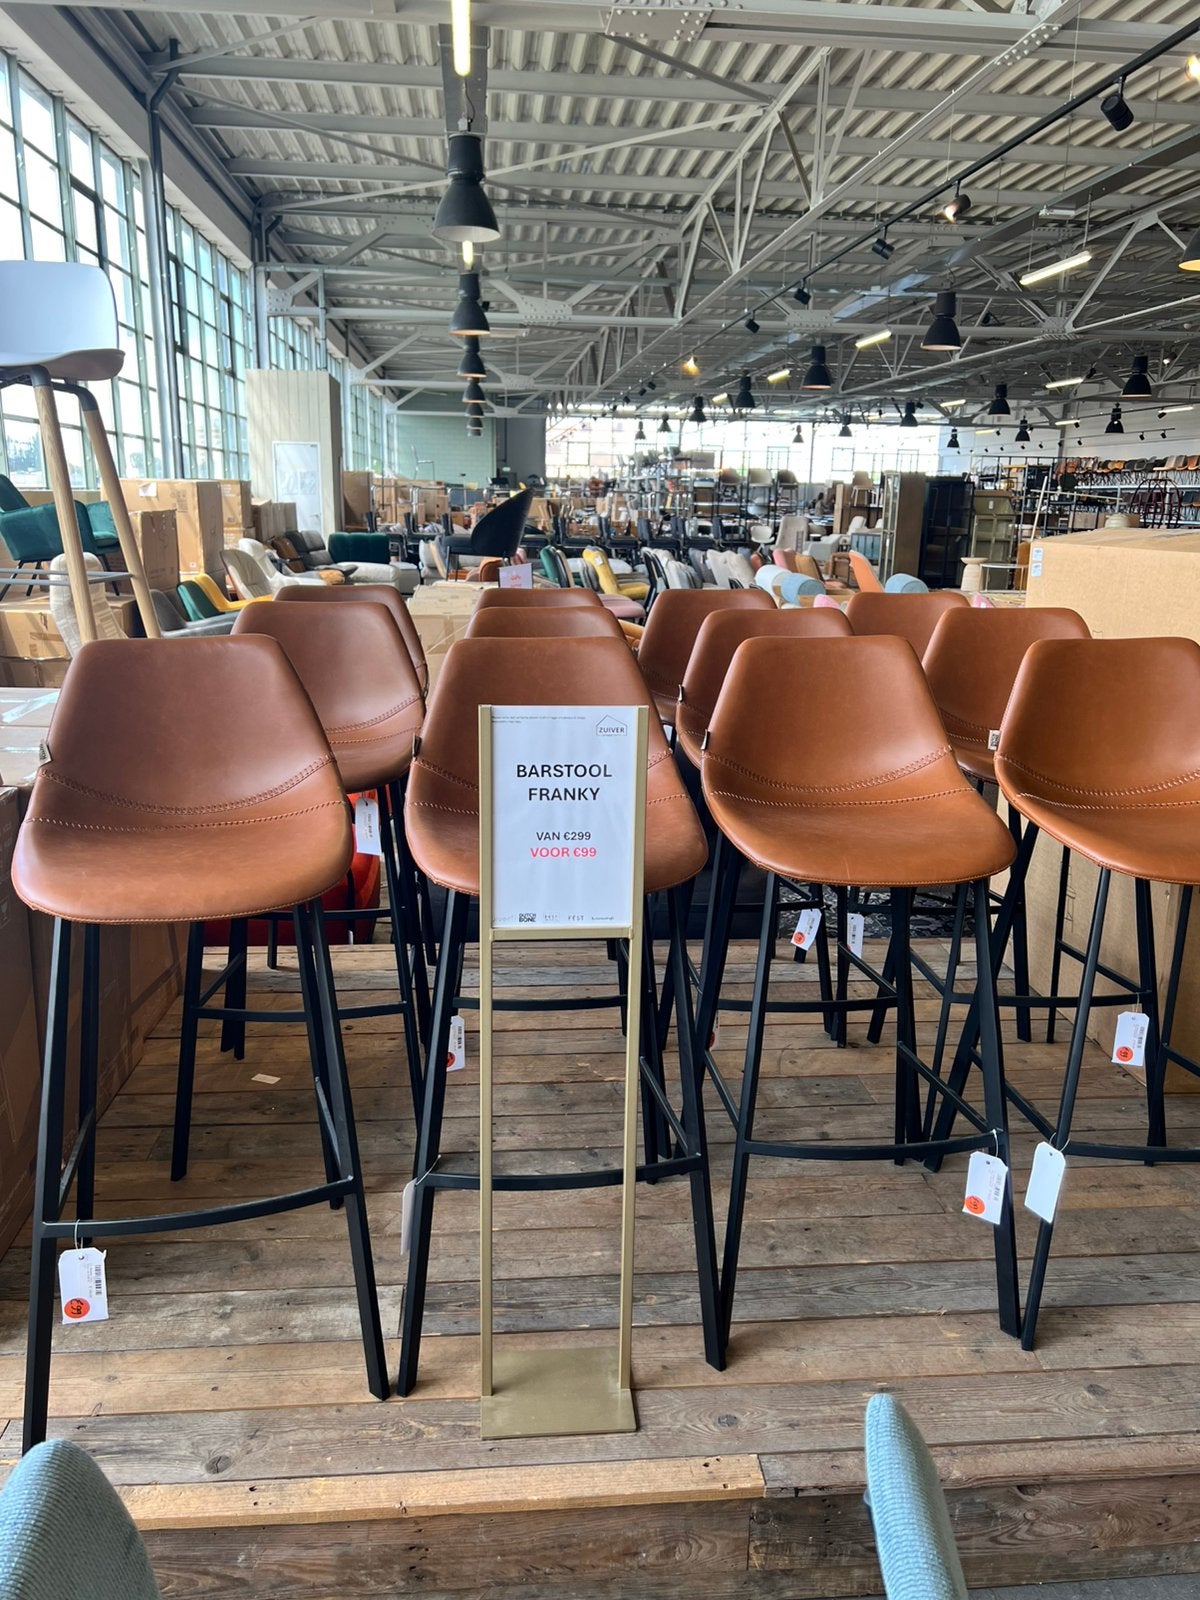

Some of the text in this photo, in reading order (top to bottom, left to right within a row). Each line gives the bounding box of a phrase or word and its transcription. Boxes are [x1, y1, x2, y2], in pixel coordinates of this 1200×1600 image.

[516, 764, 613, 778] BARSTOOL
[528, 787, 600, 801] FRANKY
[536, 831, 592, 841] VAN €299
[530, 847, 597, 858] VOOR €99
[70, 1298, 84, 1315] €99
